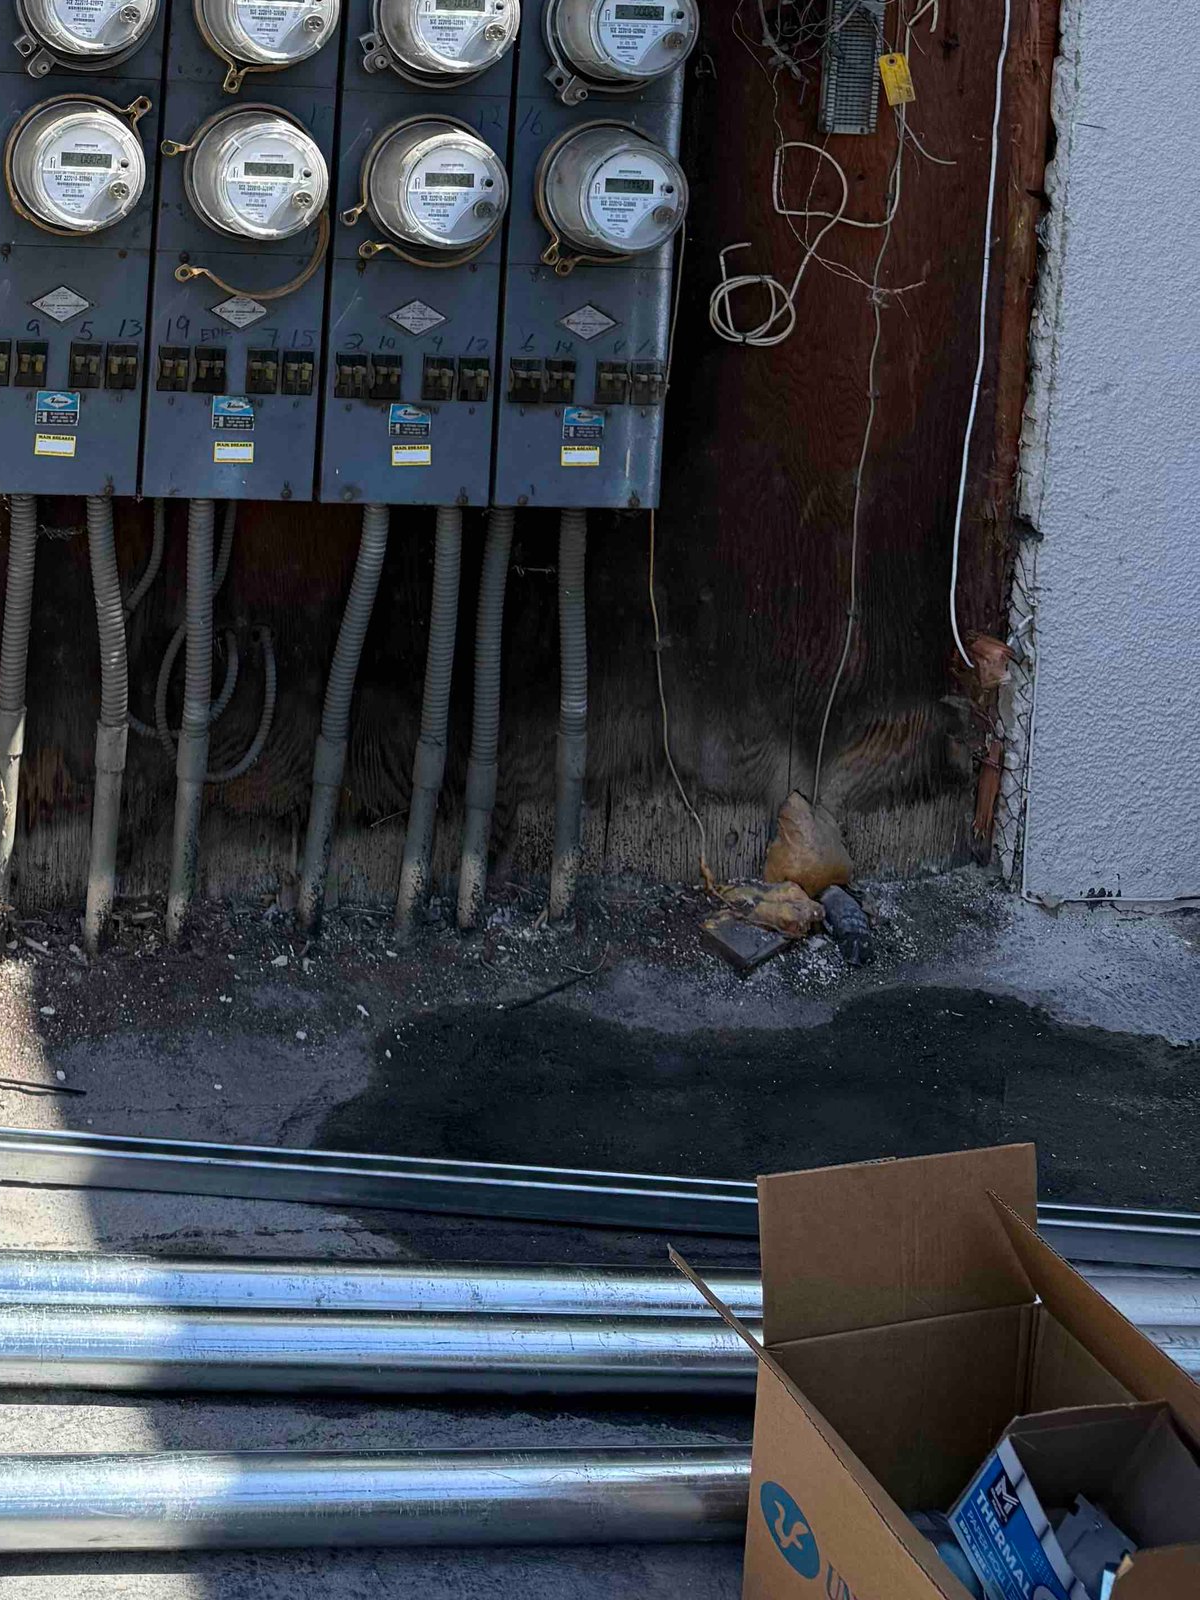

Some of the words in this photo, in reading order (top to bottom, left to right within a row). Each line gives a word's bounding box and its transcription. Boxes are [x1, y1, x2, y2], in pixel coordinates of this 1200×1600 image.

[78, 320, 95, 341] 5
[118, 319, 143, 338] 13
[165, 315, 191, 342] 19
[967, 1510, 989, 1550] PAPER
[976, 1488, 1030, 1600] THERMAL
